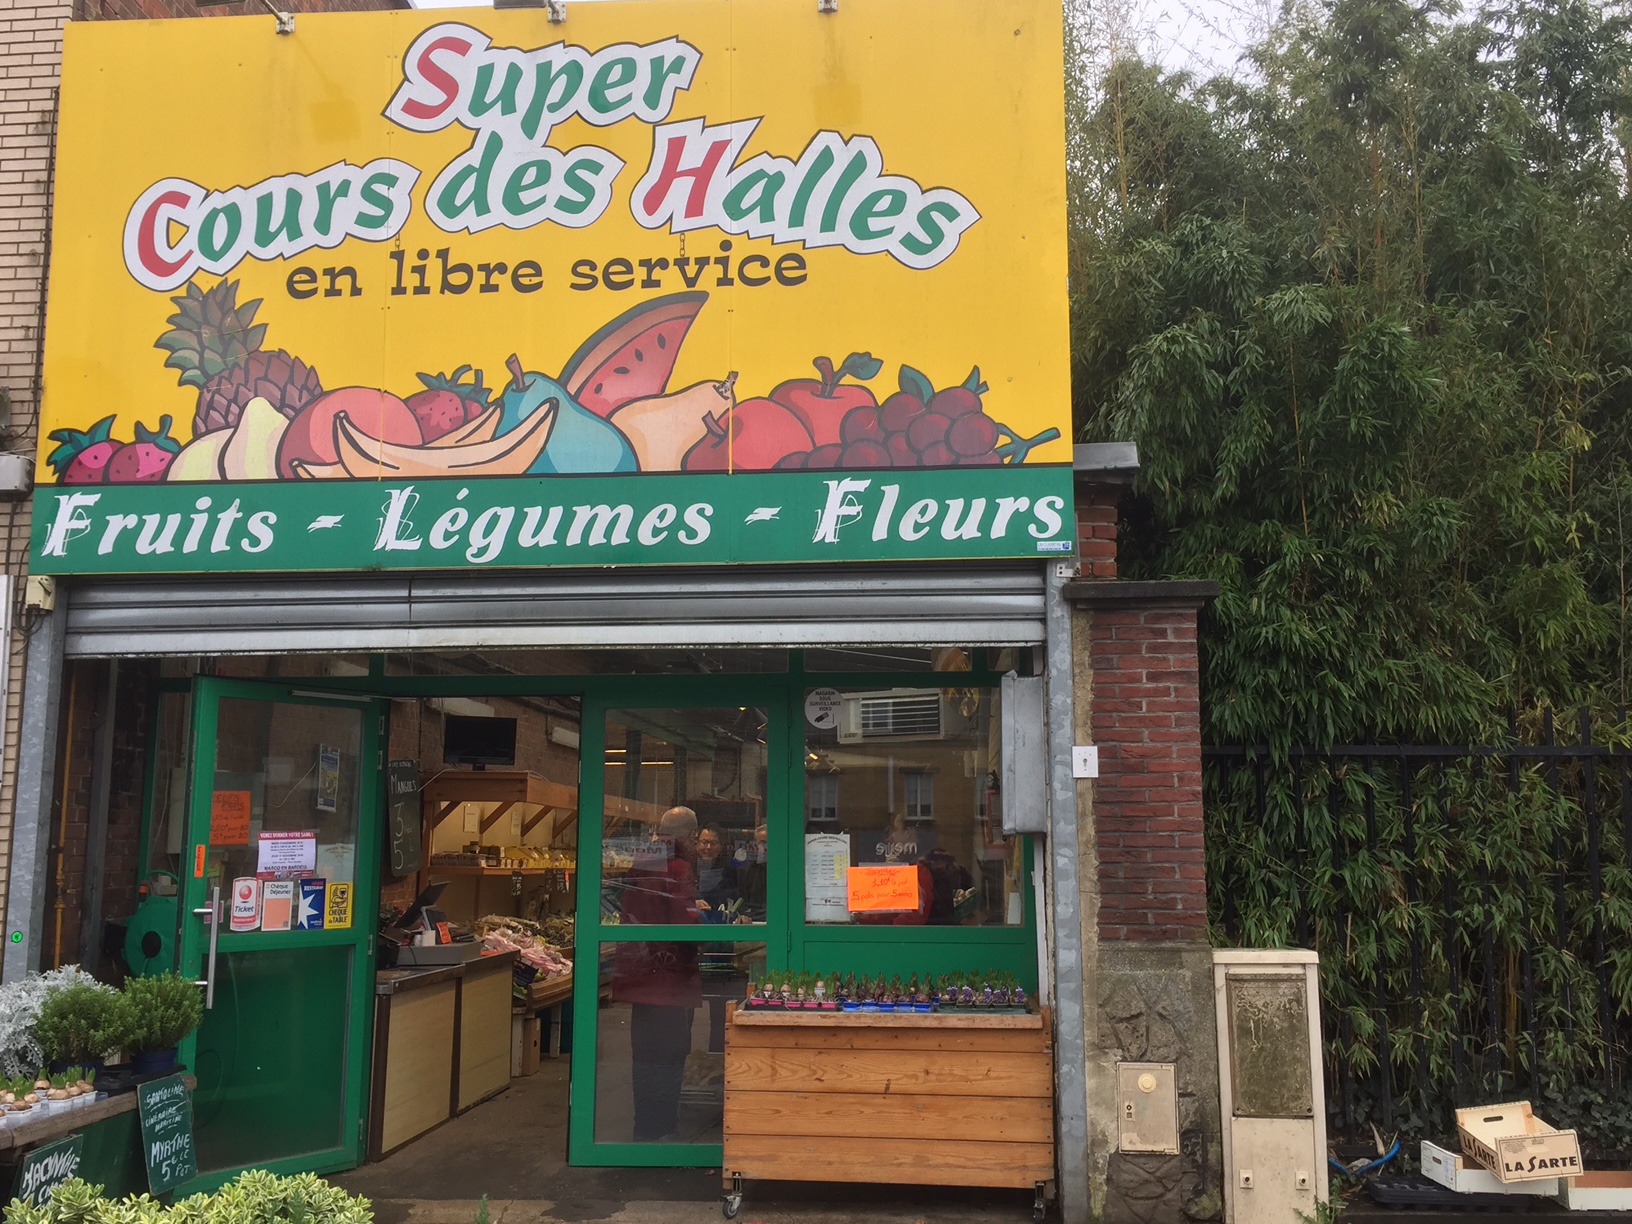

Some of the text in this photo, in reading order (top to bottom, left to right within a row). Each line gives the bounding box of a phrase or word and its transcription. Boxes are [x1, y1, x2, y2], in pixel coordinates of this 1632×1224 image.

[400, 36, 687, 141] Super
[137, 130, 961, 278] Cours des Halles
[286, 240, 809, 299] en libre service
[41, 491, 278, 557] Fruits
[373, 485, 714, 563] Légumes
[812, 477, 1064, 545] Fleurs
[876, 892, 891, 900] pour
[146, 1083, 185, 1109] SANTOLINE
[151, 1132, 191, 1168] MYRTHE
[1463, 1134, 1474, 1153] LA
[1473, 1136, 1497, 1170] SARTE
[1504, 1155, 1578, 1173] LA SARTE
